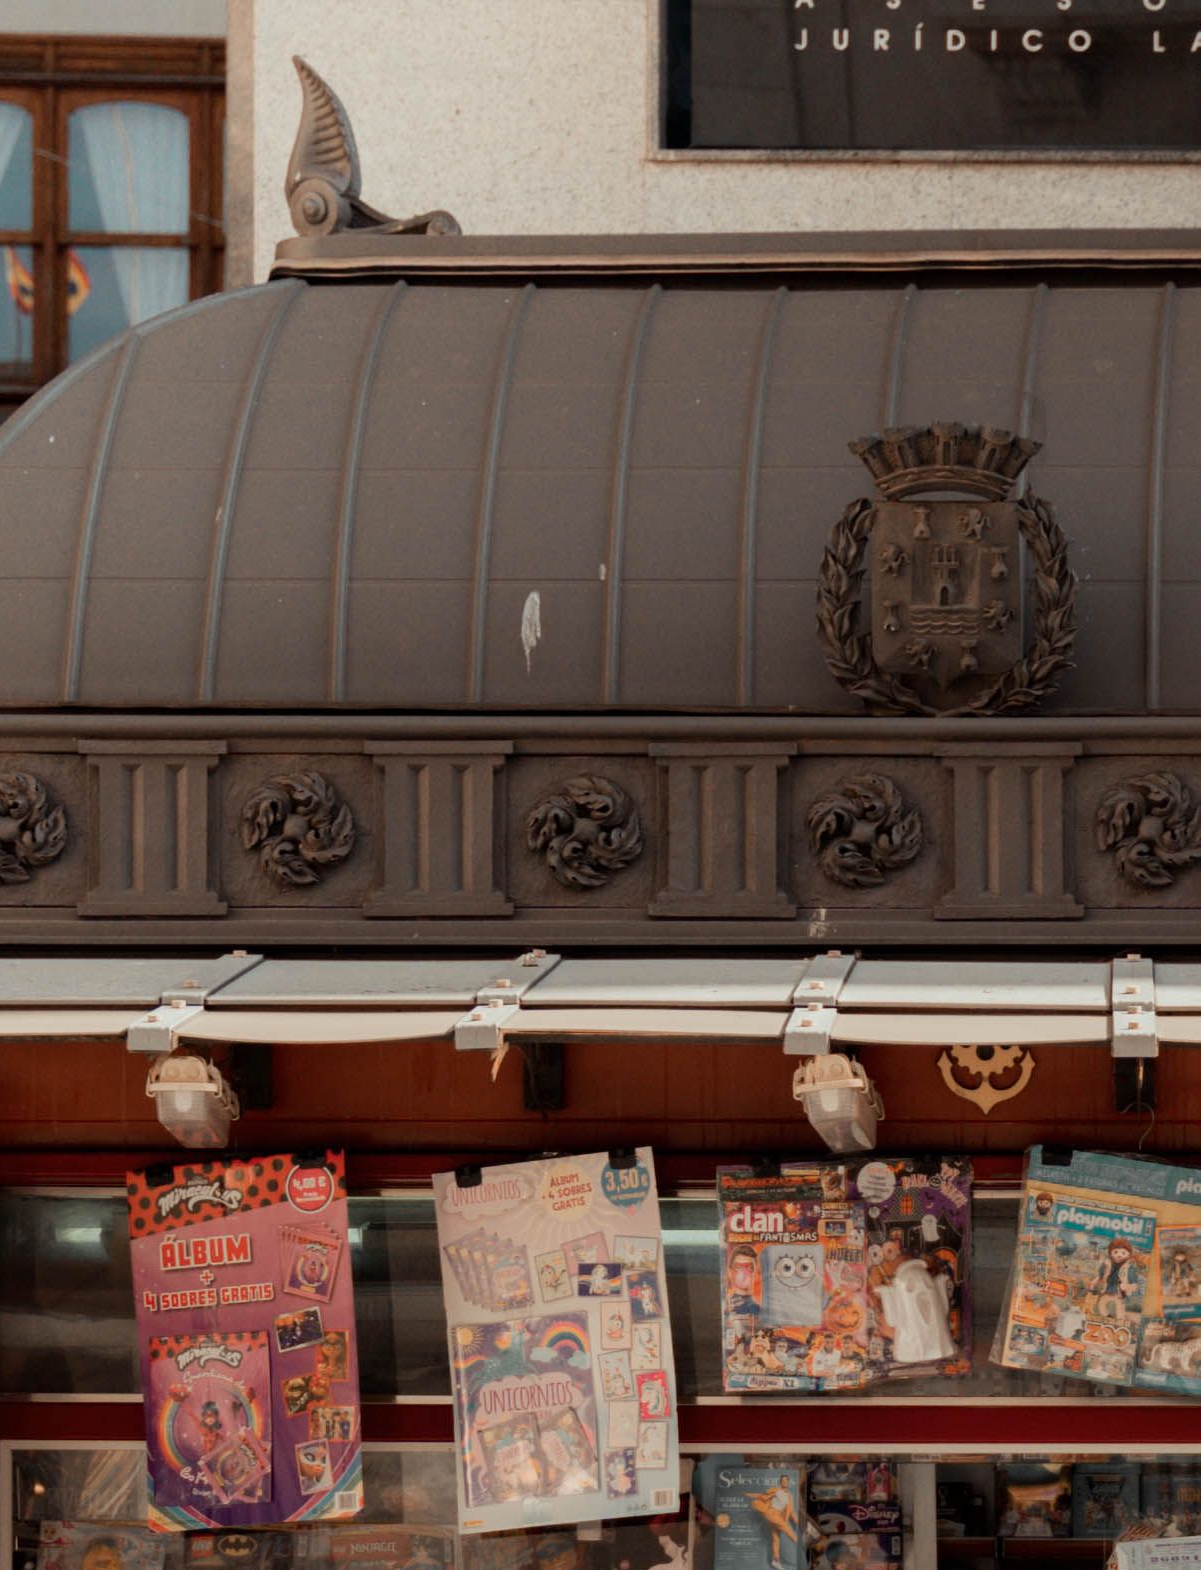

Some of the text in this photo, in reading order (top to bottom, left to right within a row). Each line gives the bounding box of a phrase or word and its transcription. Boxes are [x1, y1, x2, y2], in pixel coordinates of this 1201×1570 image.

[794, 22, 1092, 53] JURÍDICO
[557, 1183, 593, 1198] SOBRES
[605, 1169, 639, 1193] 3,50
[552, 1197, 586, 1212] GRATIS
[730, 1206, 784, 1233] clan
[1057, 1207, 1144, 1233] playmobil
[160, 1234, 252, 1270] ÁLBUM
[143, 1283, 275, 1311] 4 SOBRES GRATIS
[483, 1380, 574, 1415] UNICORNIOS
[350, 1542, 398, 1554] NINJAGO
